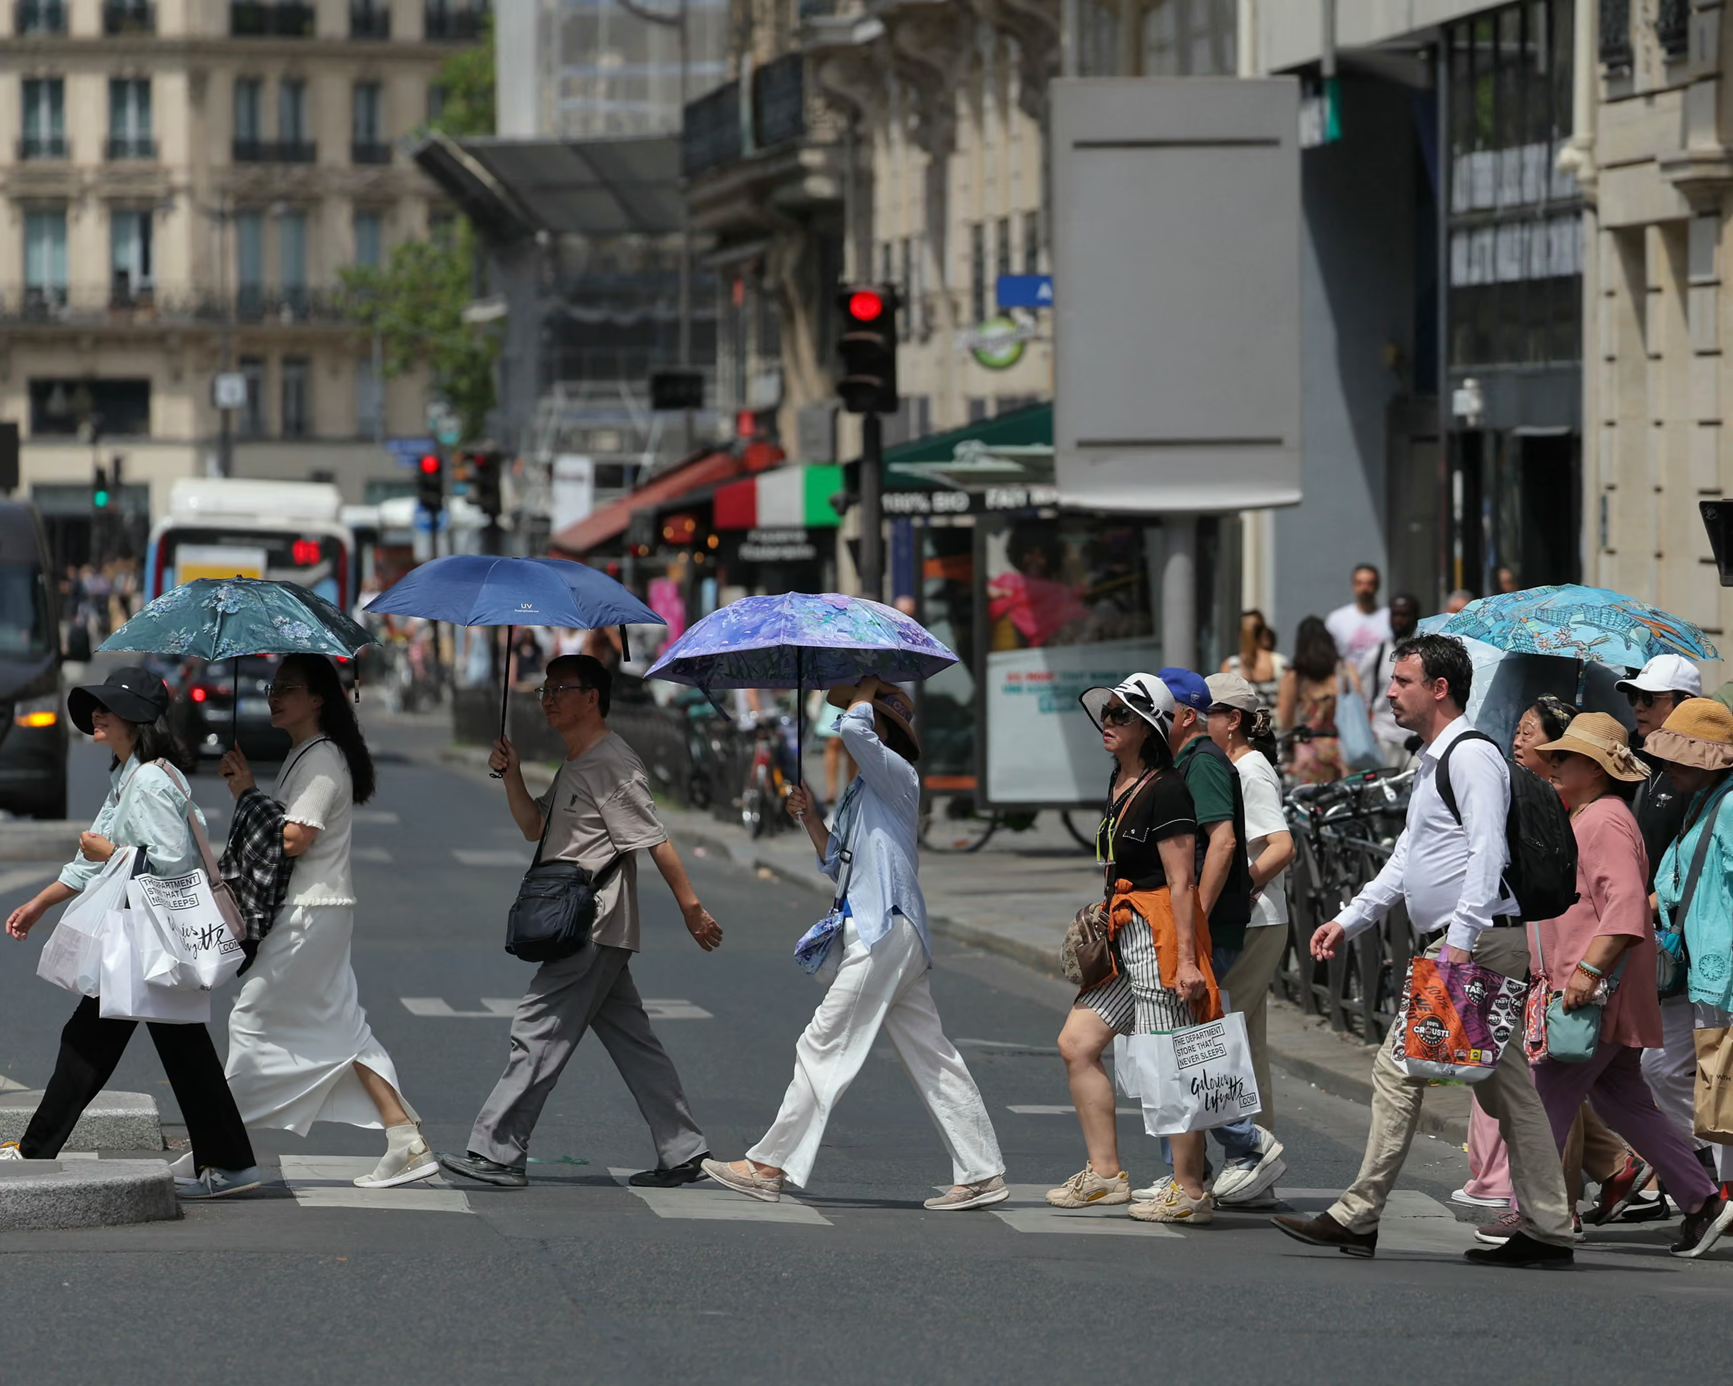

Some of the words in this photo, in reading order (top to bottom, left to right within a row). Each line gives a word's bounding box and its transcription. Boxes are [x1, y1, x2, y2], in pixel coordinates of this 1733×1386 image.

[1174, 1037, 1186, 1047] THE
[1185, 1026, 1222, 1044] DEPARTMENT
[1176, 1045, 1196, 1057] STORE
[1196, 1039, 1213, 1050] THAT
[1179, 1054, 1200, 1067] NEVER
[1200, 1046, 1224, 1060] SLEEPS
